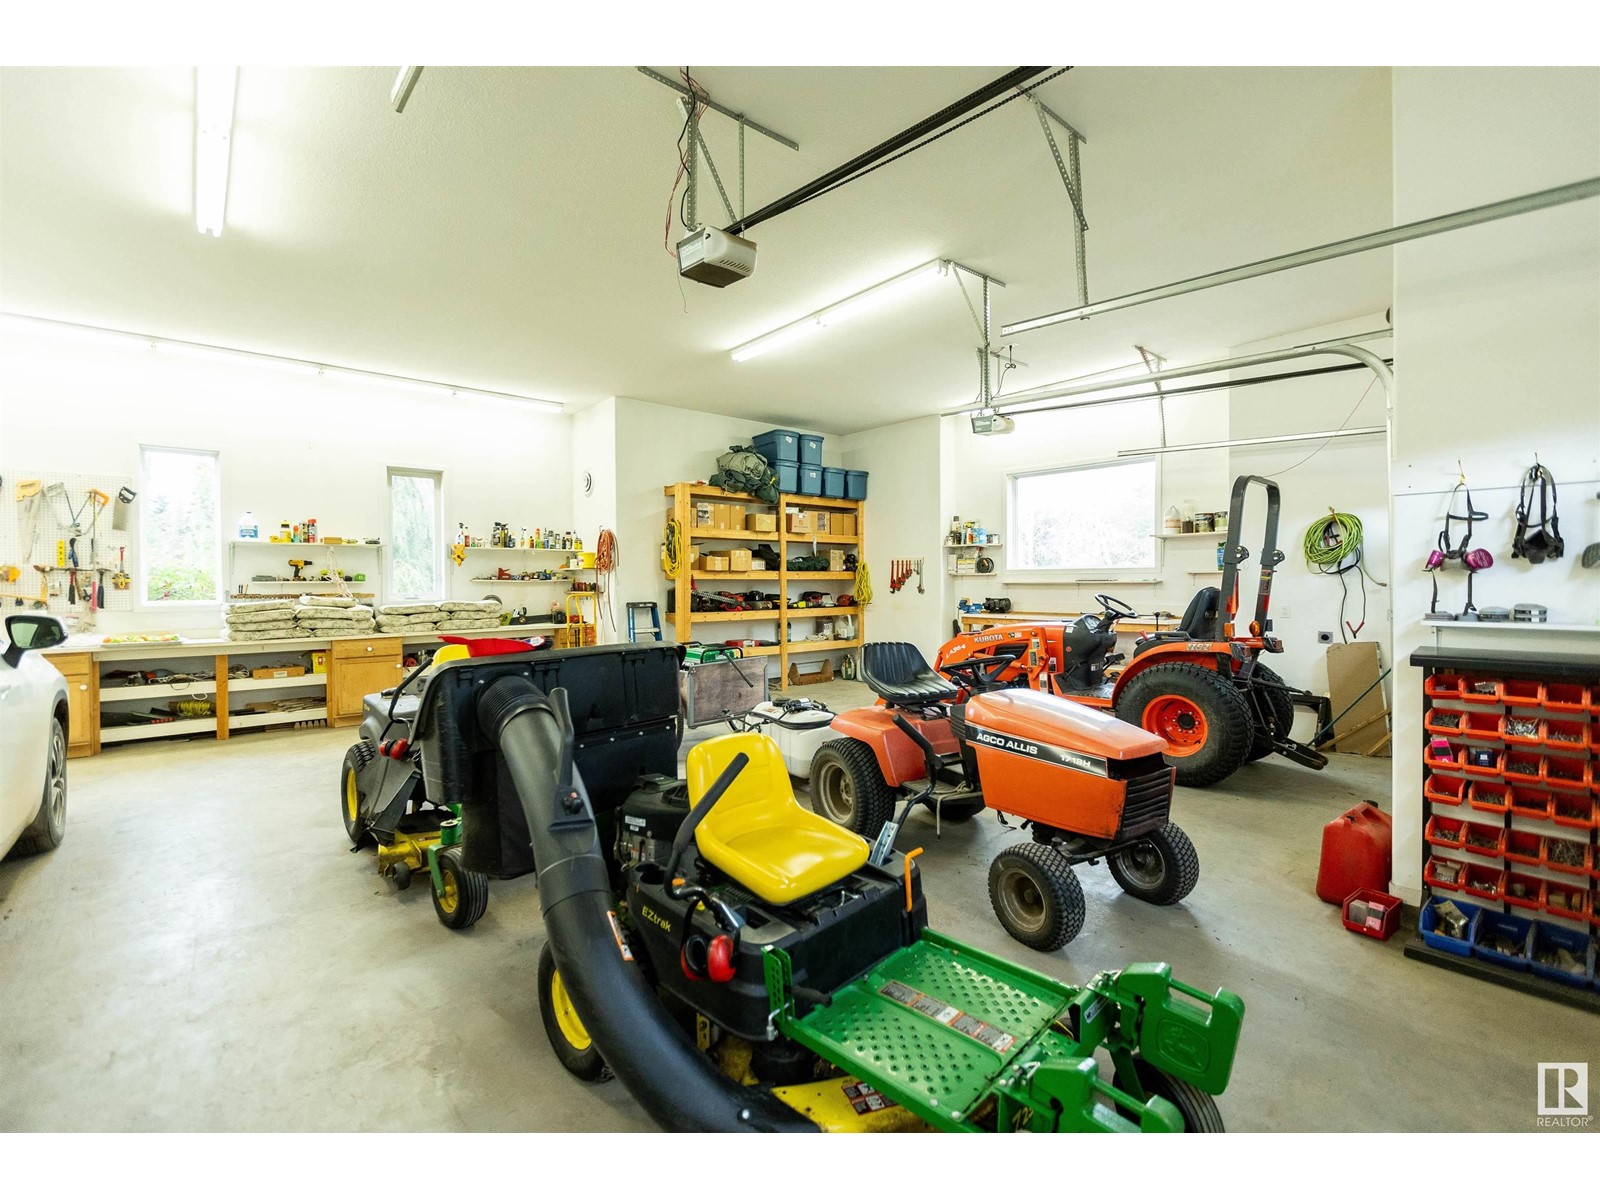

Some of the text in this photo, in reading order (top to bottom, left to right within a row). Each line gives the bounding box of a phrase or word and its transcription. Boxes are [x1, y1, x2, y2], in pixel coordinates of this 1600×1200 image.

[973, 633, 1004, 643] KUBOTA
[976, 732, 1038, 755] AGCO ALLIS
[641, 905, 671, 933] EZtrak
